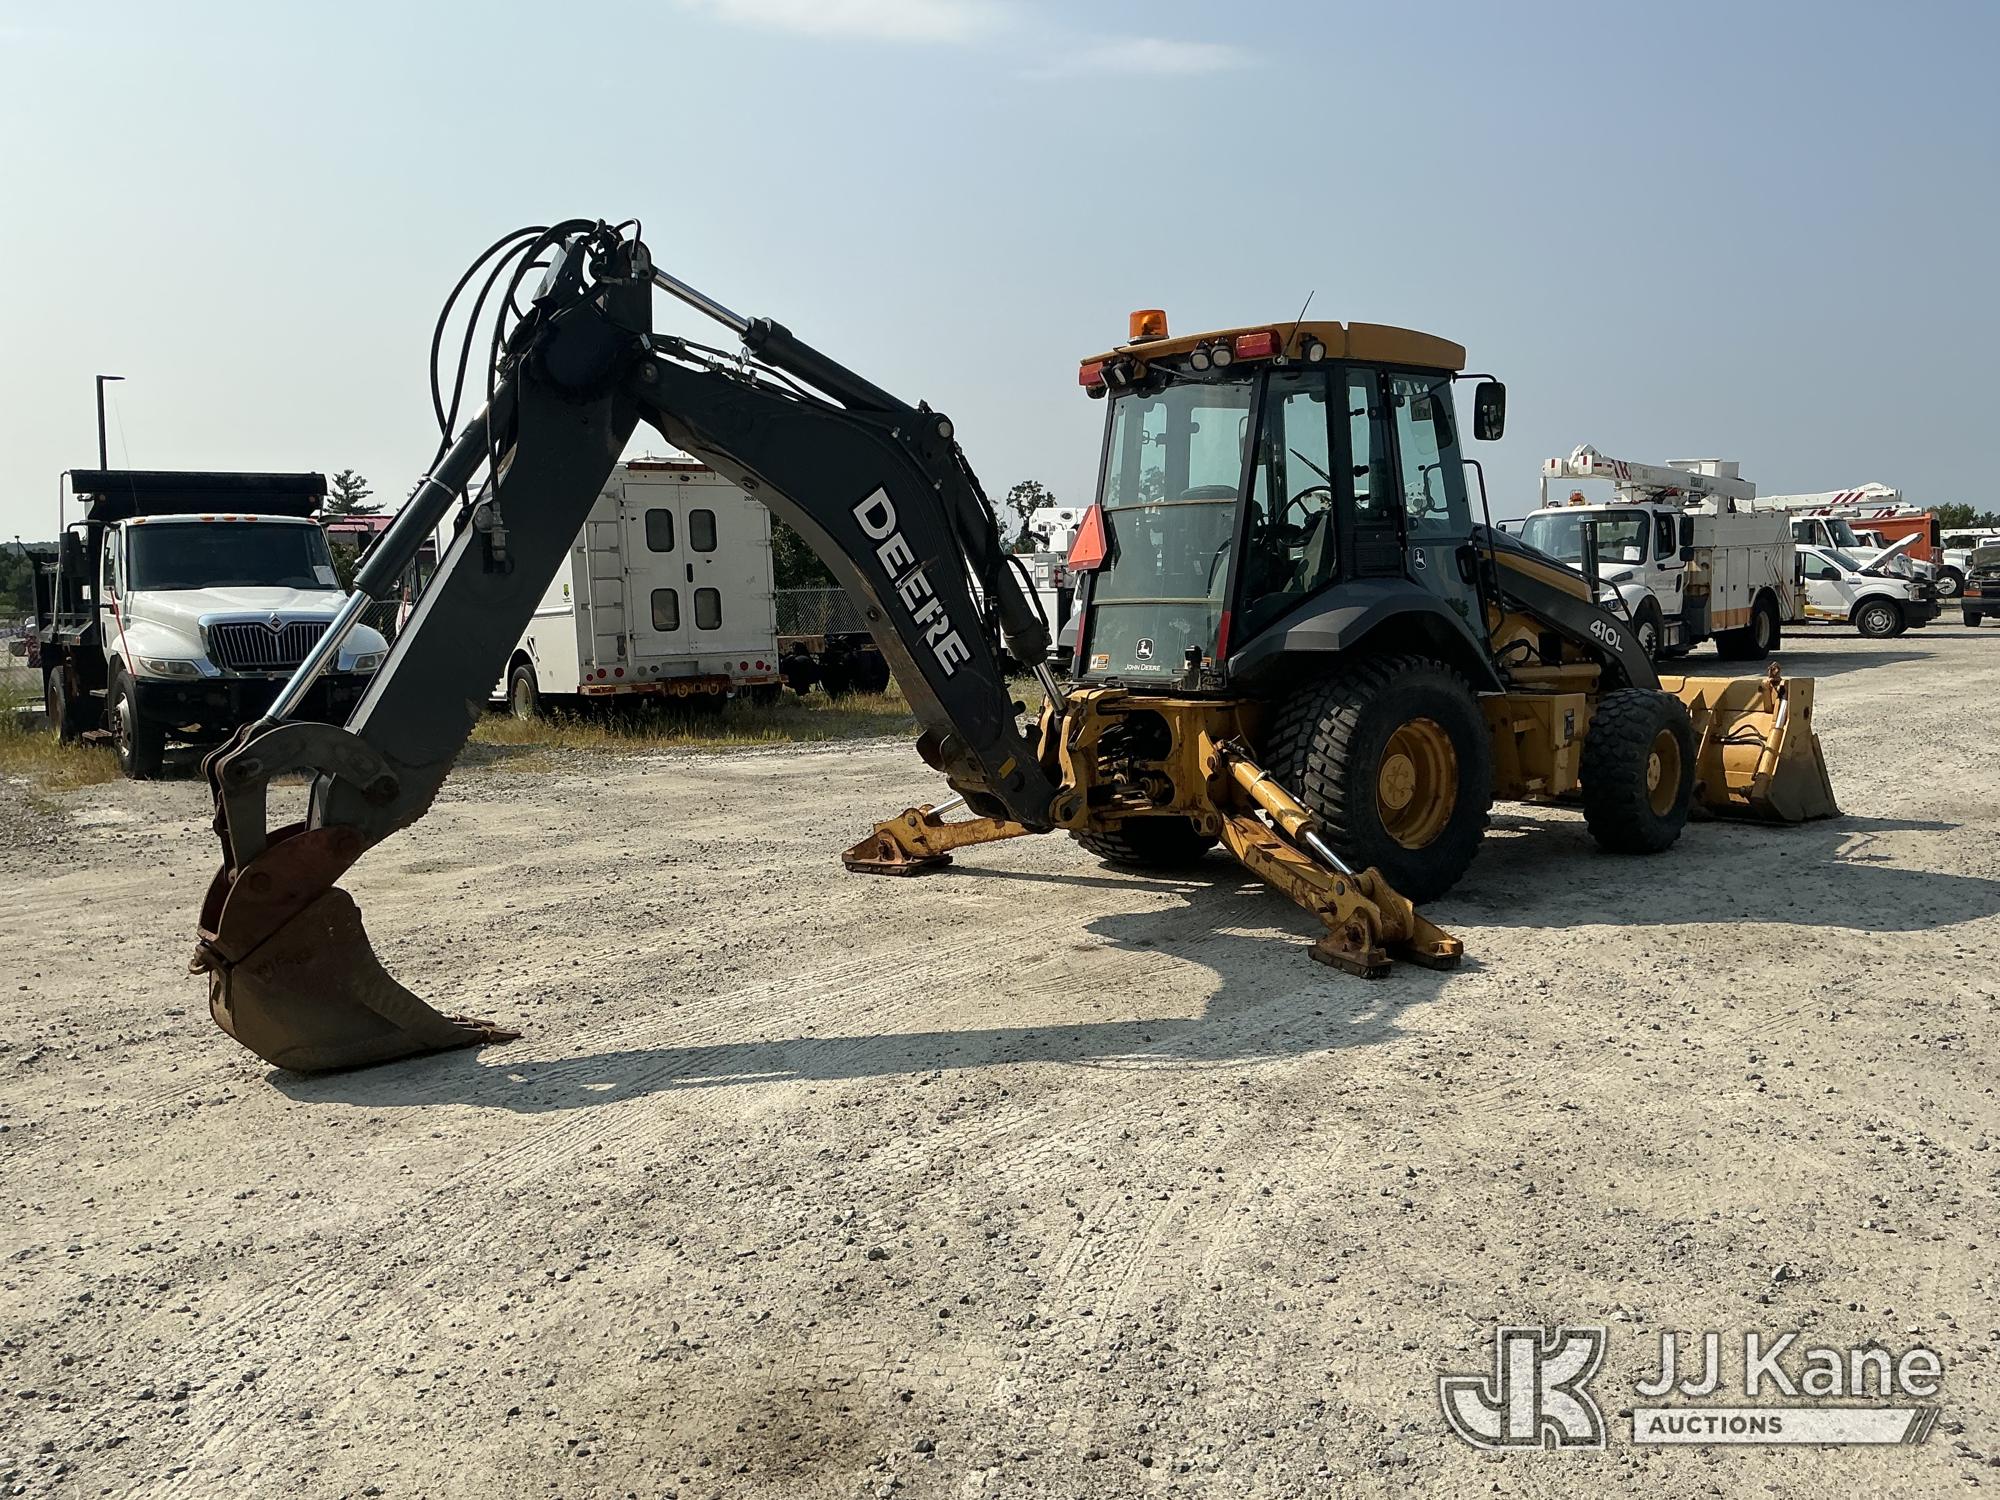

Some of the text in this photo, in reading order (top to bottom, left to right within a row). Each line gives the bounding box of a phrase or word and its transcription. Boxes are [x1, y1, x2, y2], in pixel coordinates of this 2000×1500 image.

[852, 486, 971, 677] DEERE
[1589, 619, 1624, 653] 410L
[1124, 663, 1161, 672] JOHN DEERE
